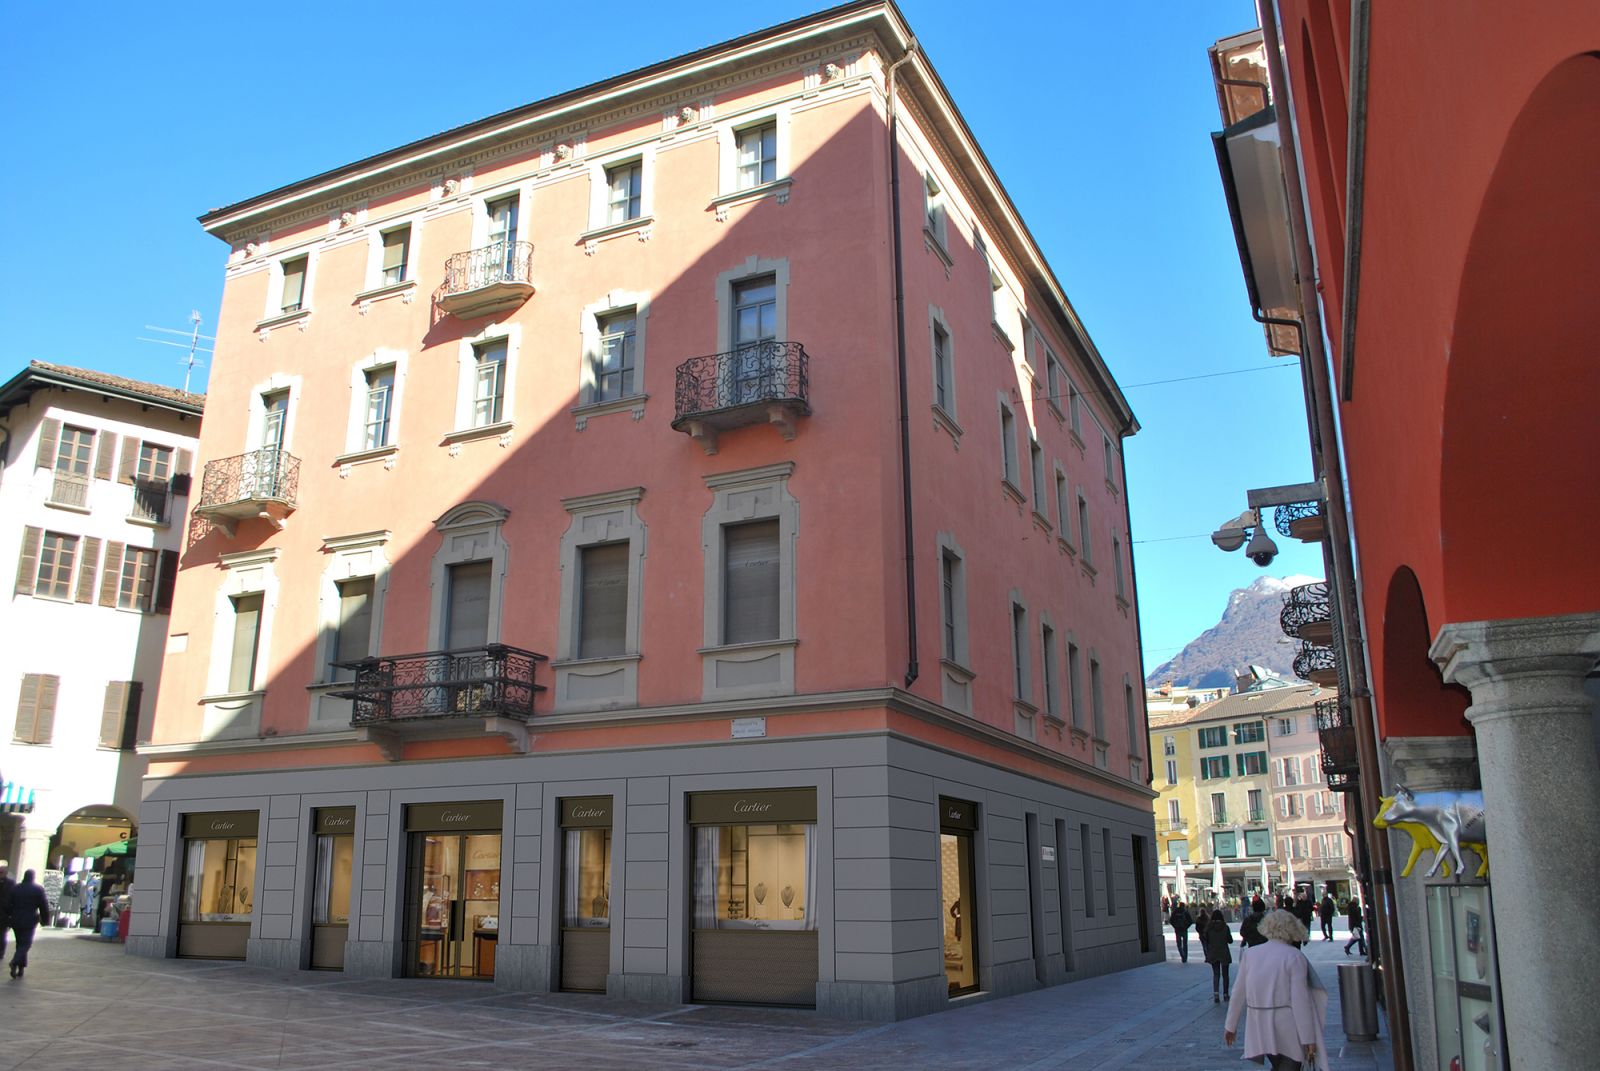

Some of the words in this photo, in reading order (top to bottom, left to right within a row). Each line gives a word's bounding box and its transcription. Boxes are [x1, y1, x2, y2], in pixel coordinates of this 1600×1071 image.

[572, 804, 606, 818] Cartier
[733, 799, 772, 813] Cartier
[441, 809, 470, 822] Cartier
[948, 806, 961, 820] Cartier
[211, 819, 234, 830] Cartier
[324, 815, 350, 826] Cartier
